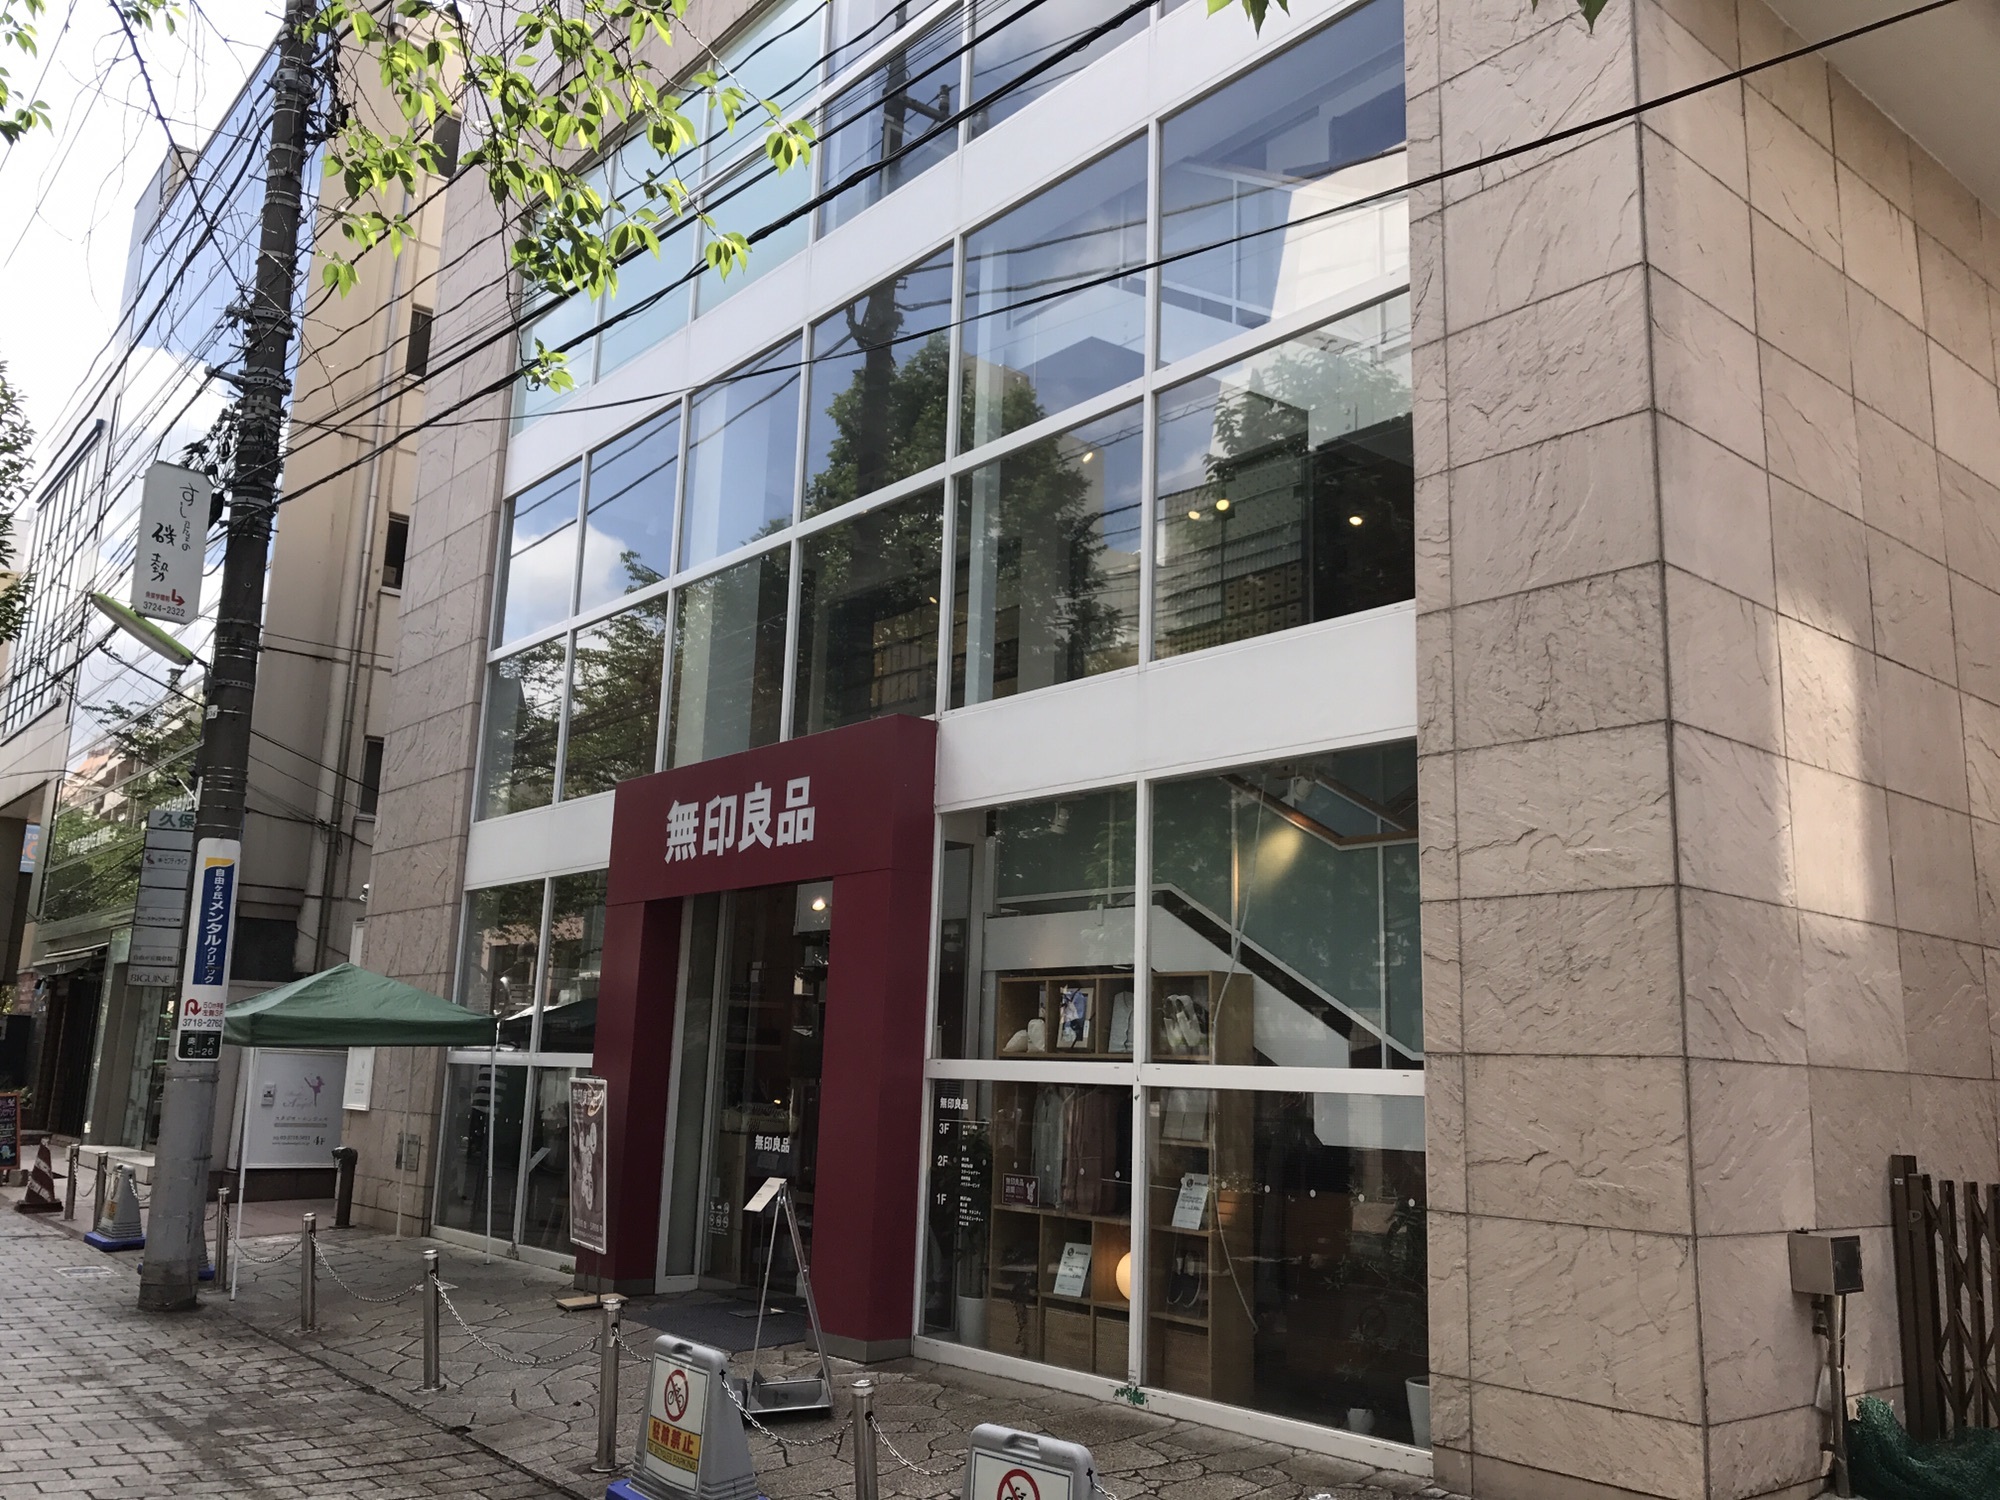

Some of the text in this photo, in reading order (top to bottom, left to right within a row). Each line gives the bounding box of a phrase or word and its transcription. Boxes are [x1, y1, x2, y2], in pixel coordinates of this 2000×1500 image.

[143, 601, 186, 617] 3724-2322
[664, 775, 816, 864] 無印良品
[187, 1047, 214, 1056] 5-26
[940, 1096, 969, 1111] 無印良品
[938, 1123, 950, 1135] 3F
[754, 1134, 790, 1154] 無印良品
[937, 1155, 949, 1167] 2F
[936, 1193, 948, 1206] 1F
[652, 1420, 694, 1456] 駐輪禁止
